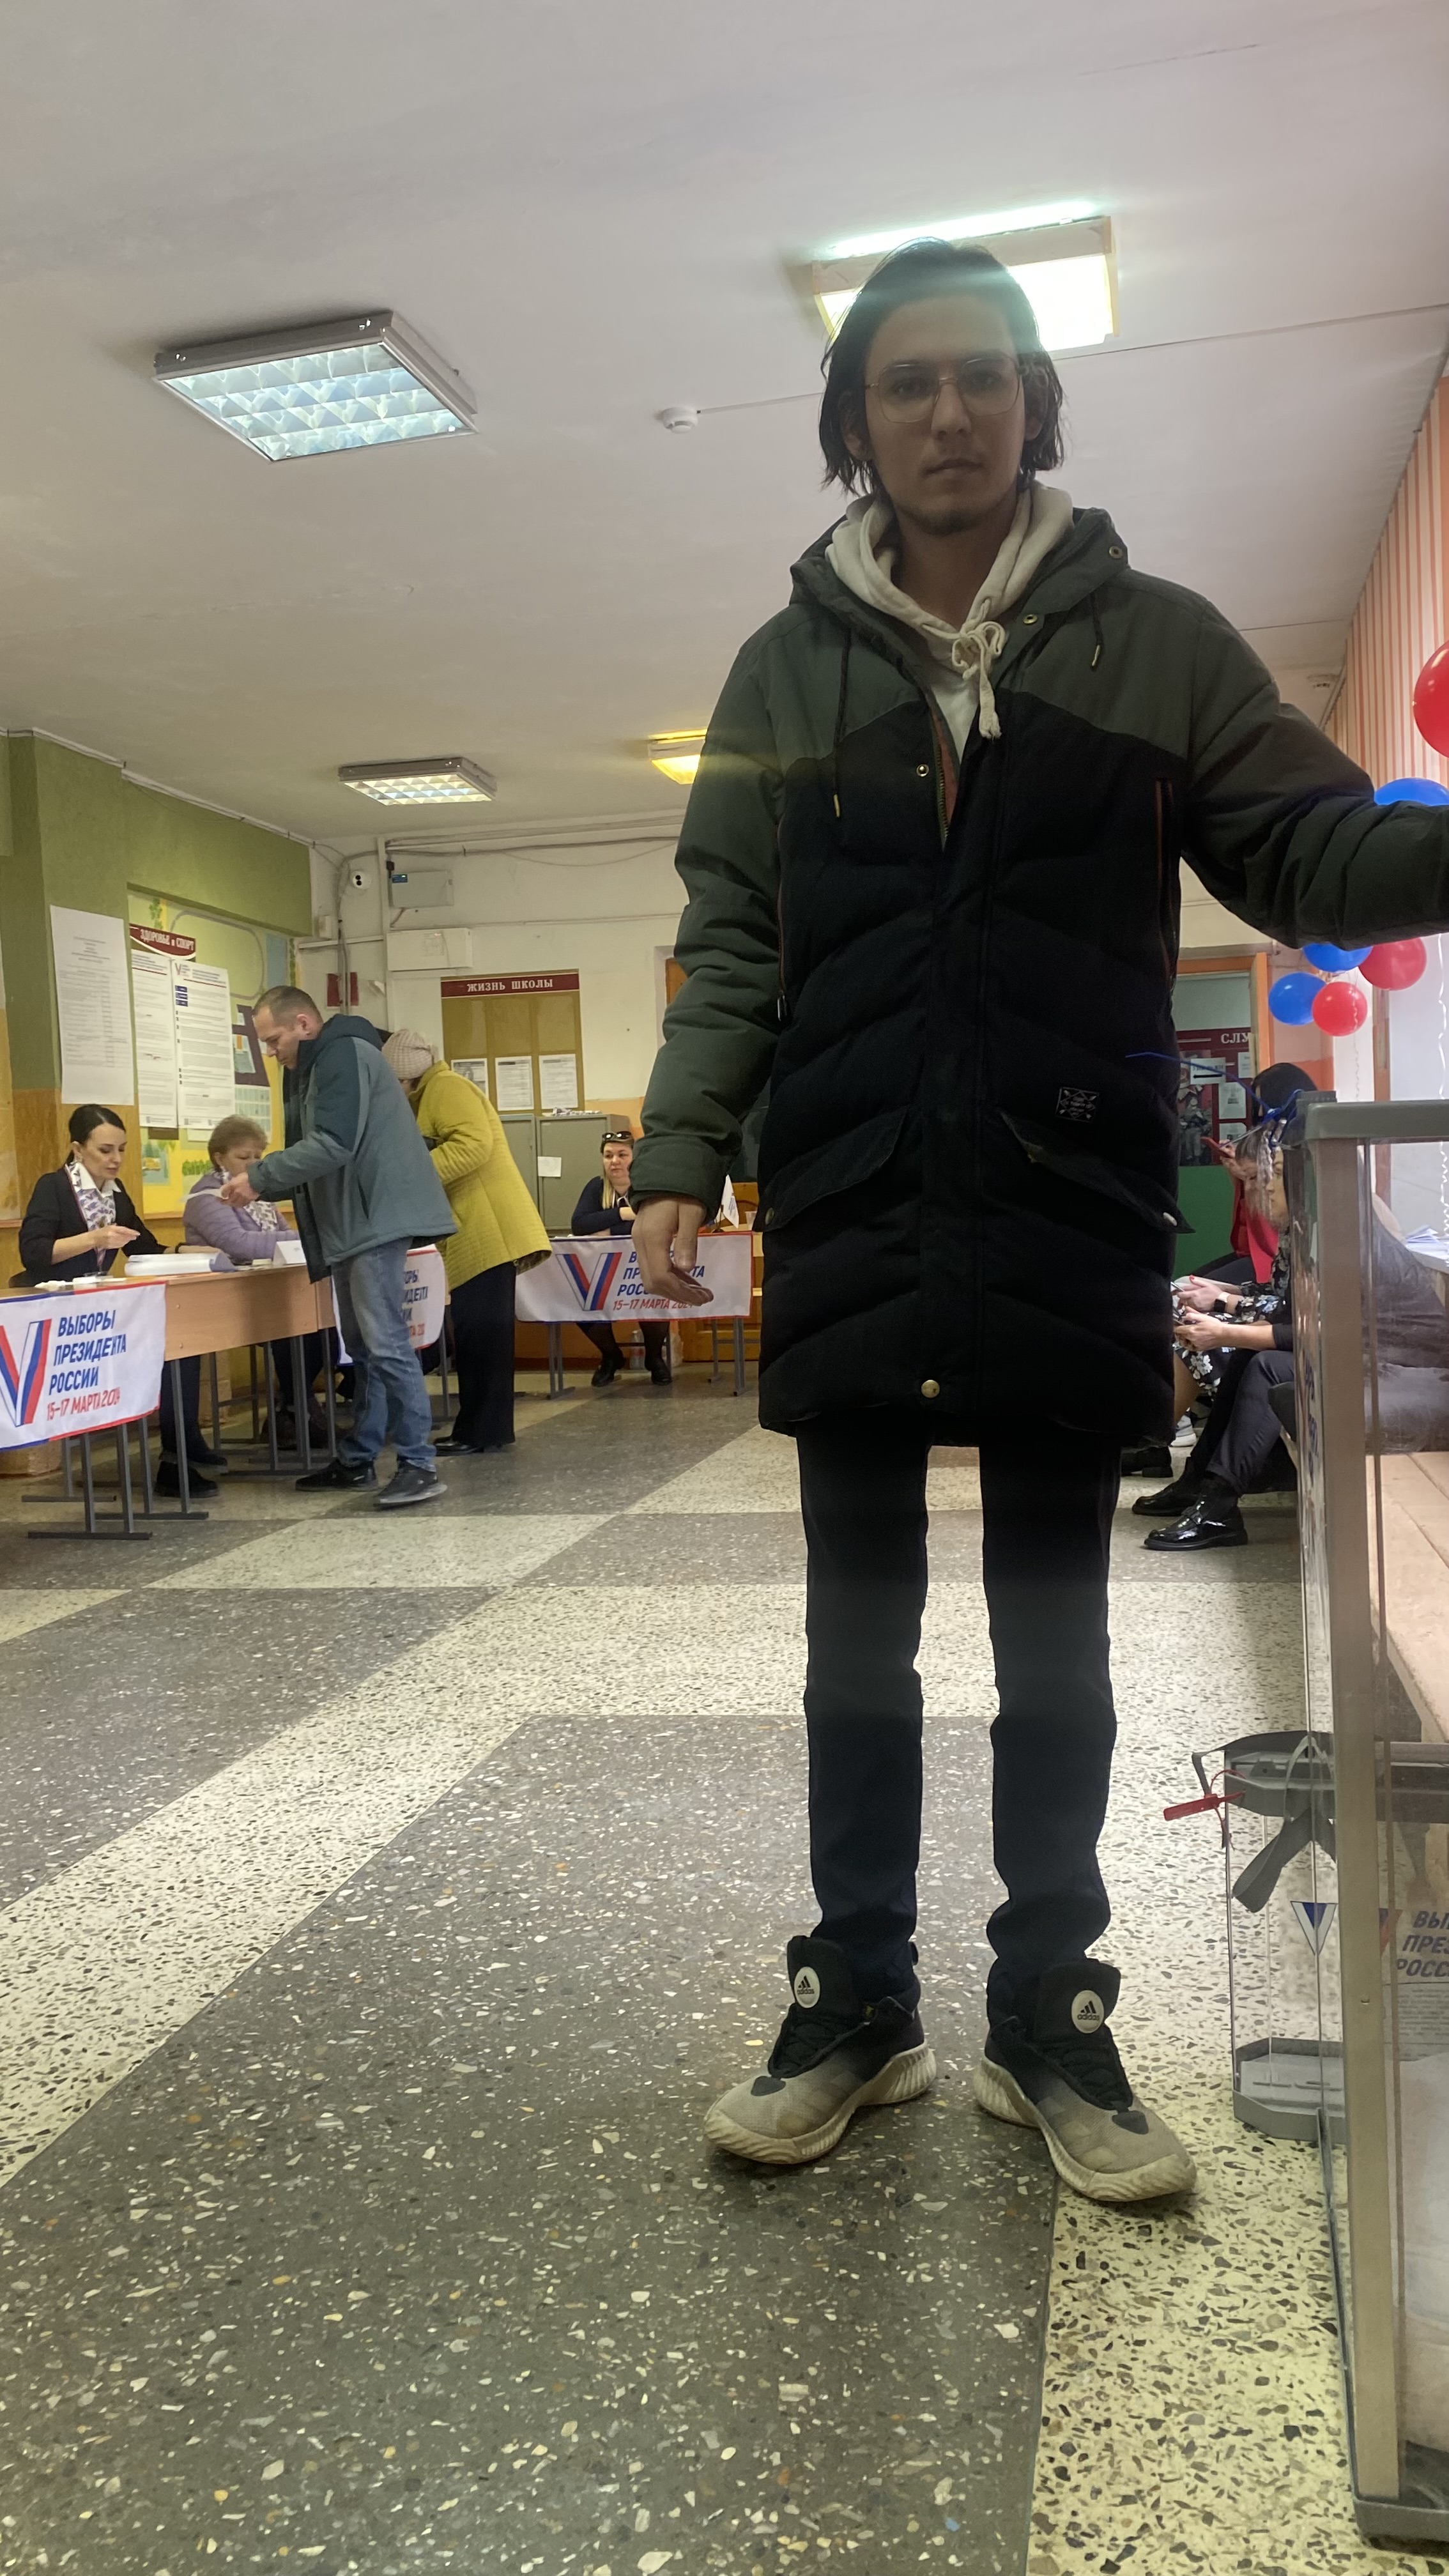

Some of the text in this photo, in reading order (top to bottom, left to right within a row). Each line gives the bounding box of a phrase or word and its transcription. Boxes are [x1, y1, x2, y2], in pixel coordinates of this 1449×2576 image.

[176, 937, 194, 951] СПОРТ
[467, 979, 553, 992] ЖИЗНЬ ШКОЛЫ
[640, 1298, 670, 1310] МАРТА
[57, 1310, 116, 1337] ВЫБОРЫ
[54, 1334, 126, 1367] ПРЕЗИДЕНТА
[49, 1366, 99, 1395] РОССИИ
[1413, 1911, 1449, 1929] ВЫ
[1077, 2012, 1100, 2021] adidas
